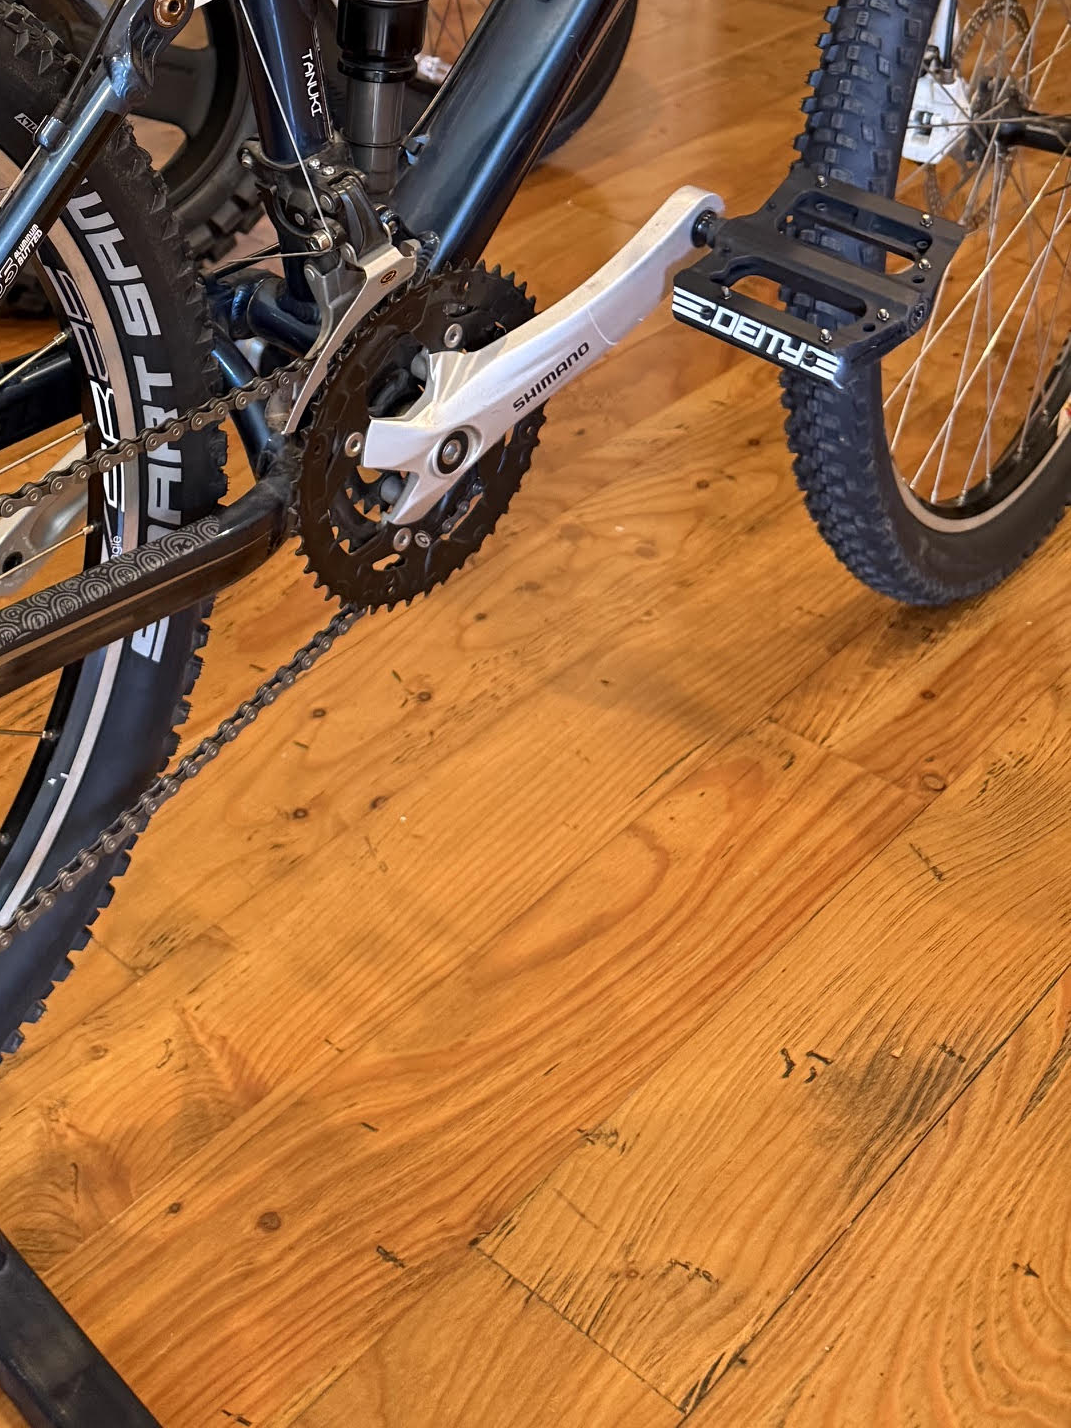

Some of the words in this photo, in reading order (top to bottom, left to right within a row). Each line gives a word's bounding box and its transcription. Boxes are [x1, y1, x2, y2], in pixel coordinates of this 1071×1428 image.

[302, 48, 323, 117] TANUKI
[13, 223, 39, 260] ALUMINUM
[17, 229, 43, 266] BUTTED
[710, 305, 807, 366] DEITY
[512, 341, 590, 412] SHIMANO
[130, 355, 183, 663] SART
